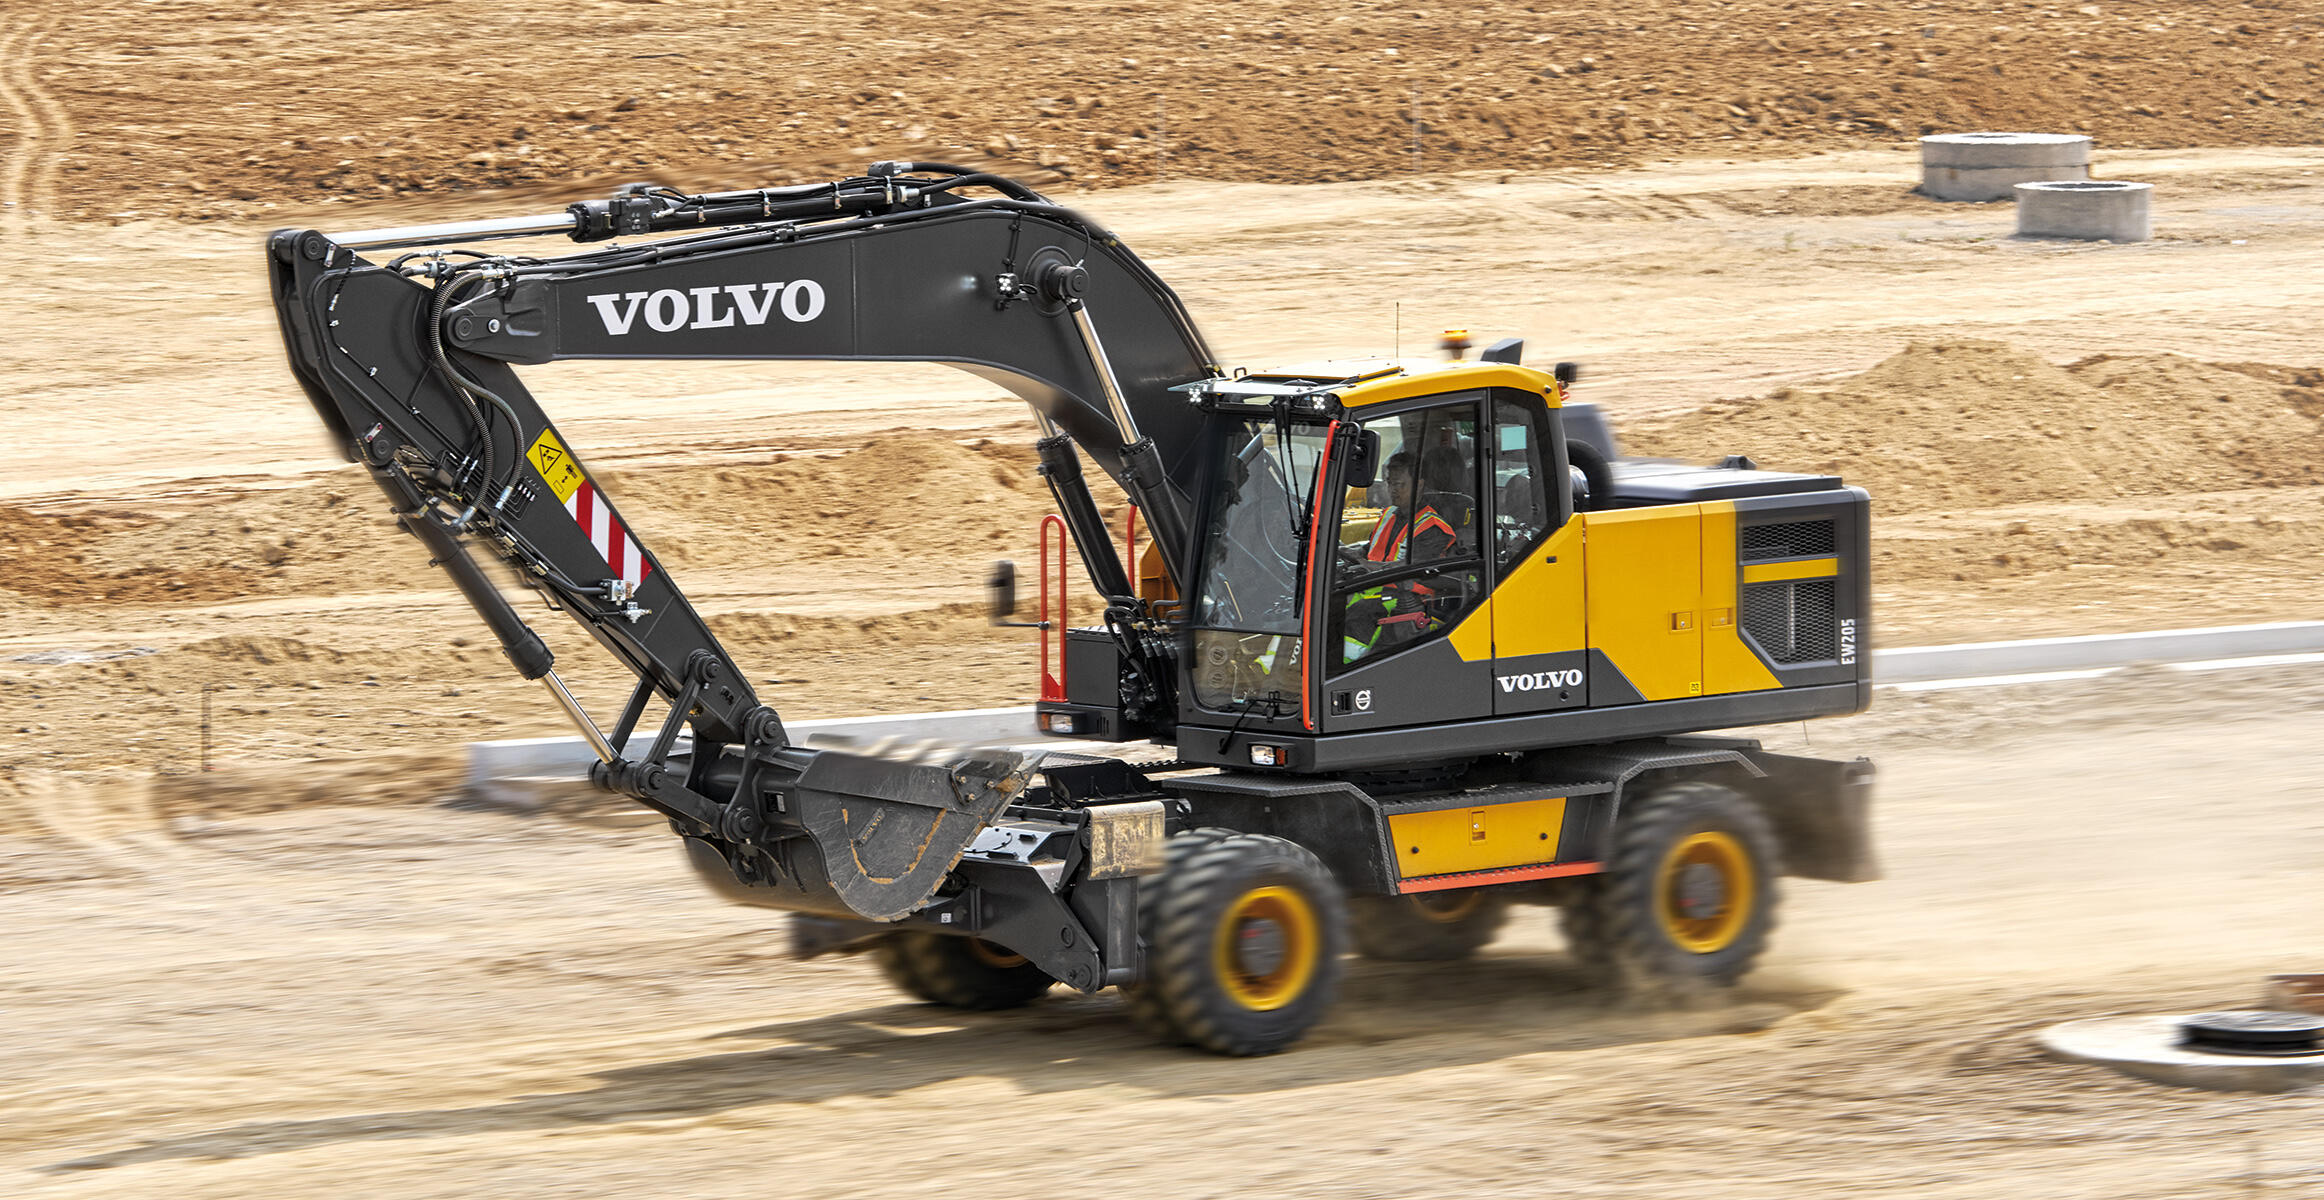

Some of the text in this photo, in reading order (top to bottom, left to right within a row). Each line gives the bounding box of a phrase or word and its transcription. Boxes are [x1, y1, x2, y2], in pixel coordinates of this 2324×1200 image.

[587, 279, 825, 336] VOLVO
[1841, 618, 1856, 665] EW205
[1497, 668, 1583, 693] VOLVO
